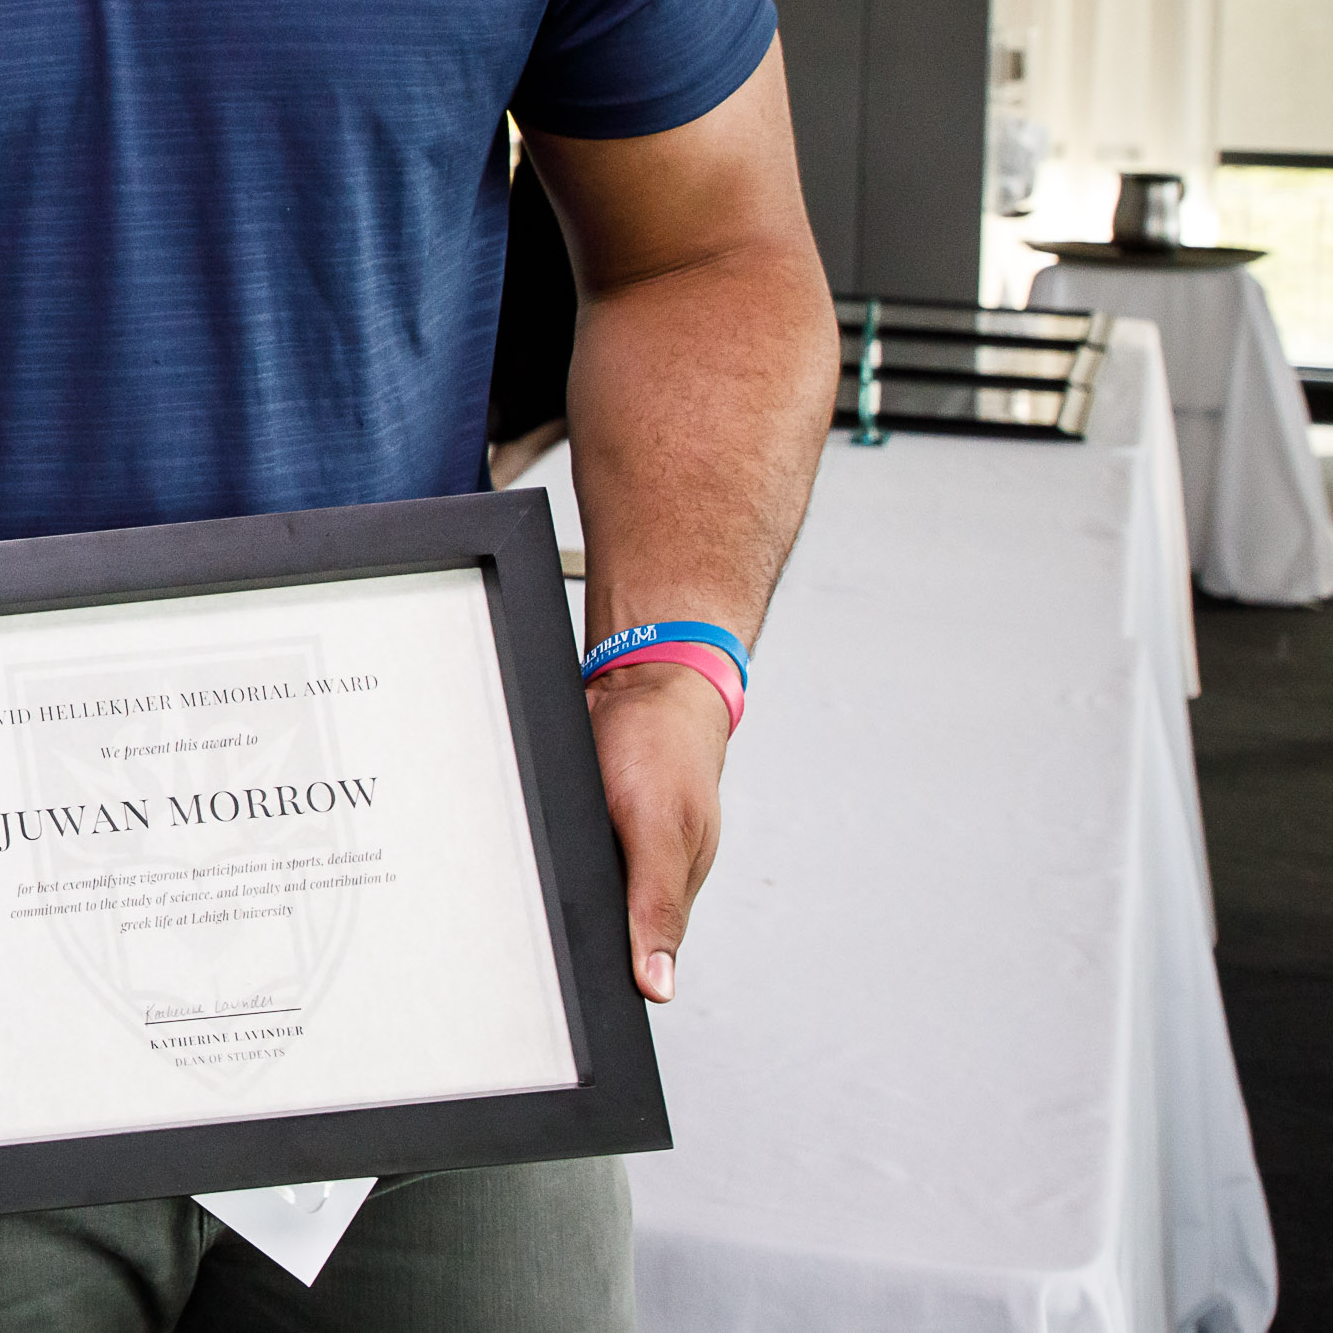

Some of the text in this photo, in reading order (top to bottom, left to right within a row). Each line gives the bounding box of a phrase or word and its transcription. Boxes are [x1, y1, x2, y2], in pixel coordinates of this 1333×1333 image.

[39, 694, 173, 722] HELLEKJAER
[180, 682, 296, 709] MEMORIAL
[303, 674, 378, 698] AWARD
[100, 733, 258, 760] We present this award to
[166, 776, 378, 828] MORROW
[17, 848, 383, 898] for best exemplifying vigorous participation in sports, dedicated
[10, 871, 397, 919] commitment to the study of science, and loyalty and contribution to
[119, 904, 294, 934] greek life at Lehigh University
[150, 1025, 305, 1050] KATHERINE LAVINDER
[175, 1047, 286, 1067] DEAN OF STUDENTS
